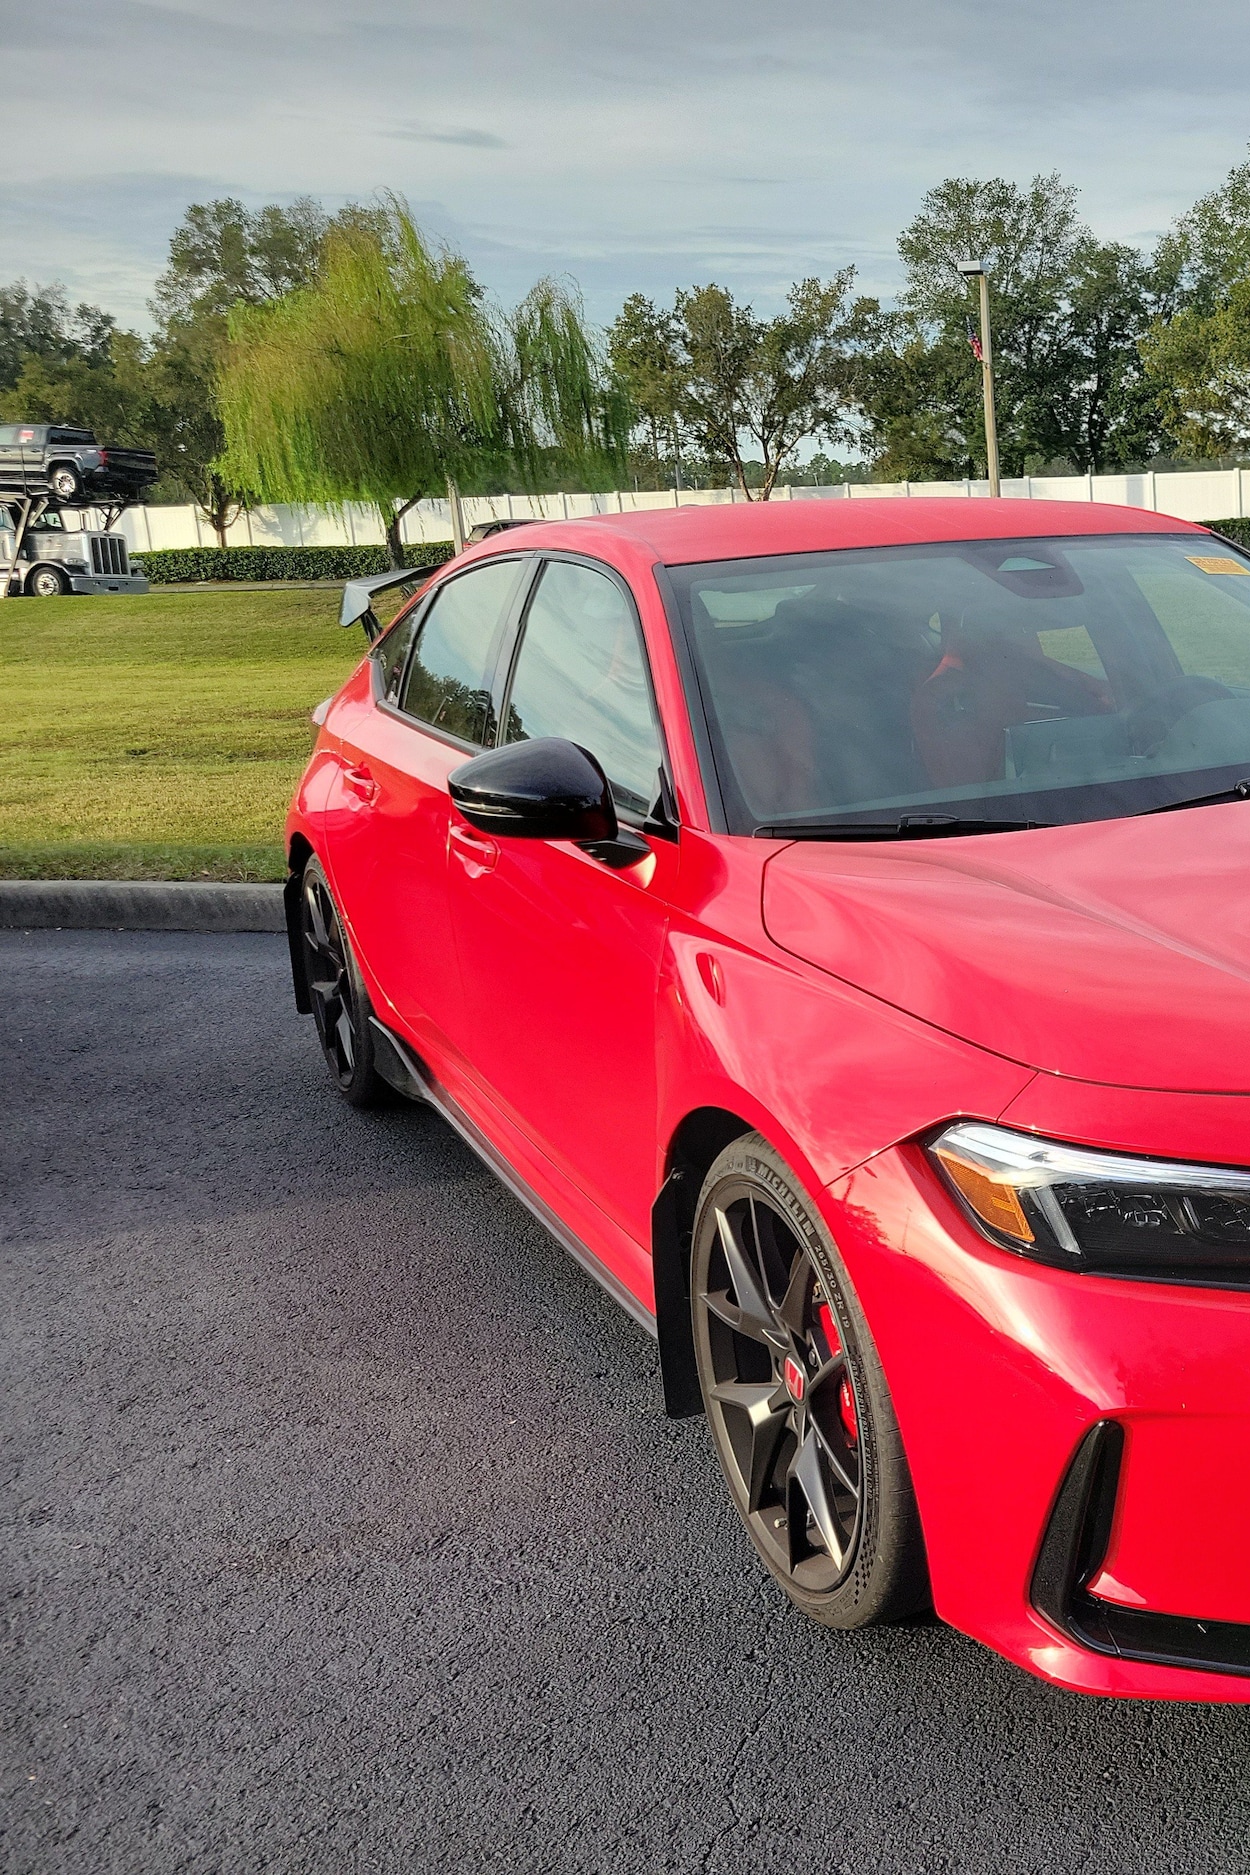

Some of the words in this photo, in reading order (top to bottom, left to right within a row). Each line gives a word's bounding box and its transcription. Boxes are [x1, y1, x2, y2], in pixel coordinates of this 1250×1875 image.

[758, 1162, 816, 1237] MICHELIN
[814, 1245, 837, 1288] 265/30
[834, 1293, 844, 1310] ZR
[841, 1316, 850, 1328] 19
